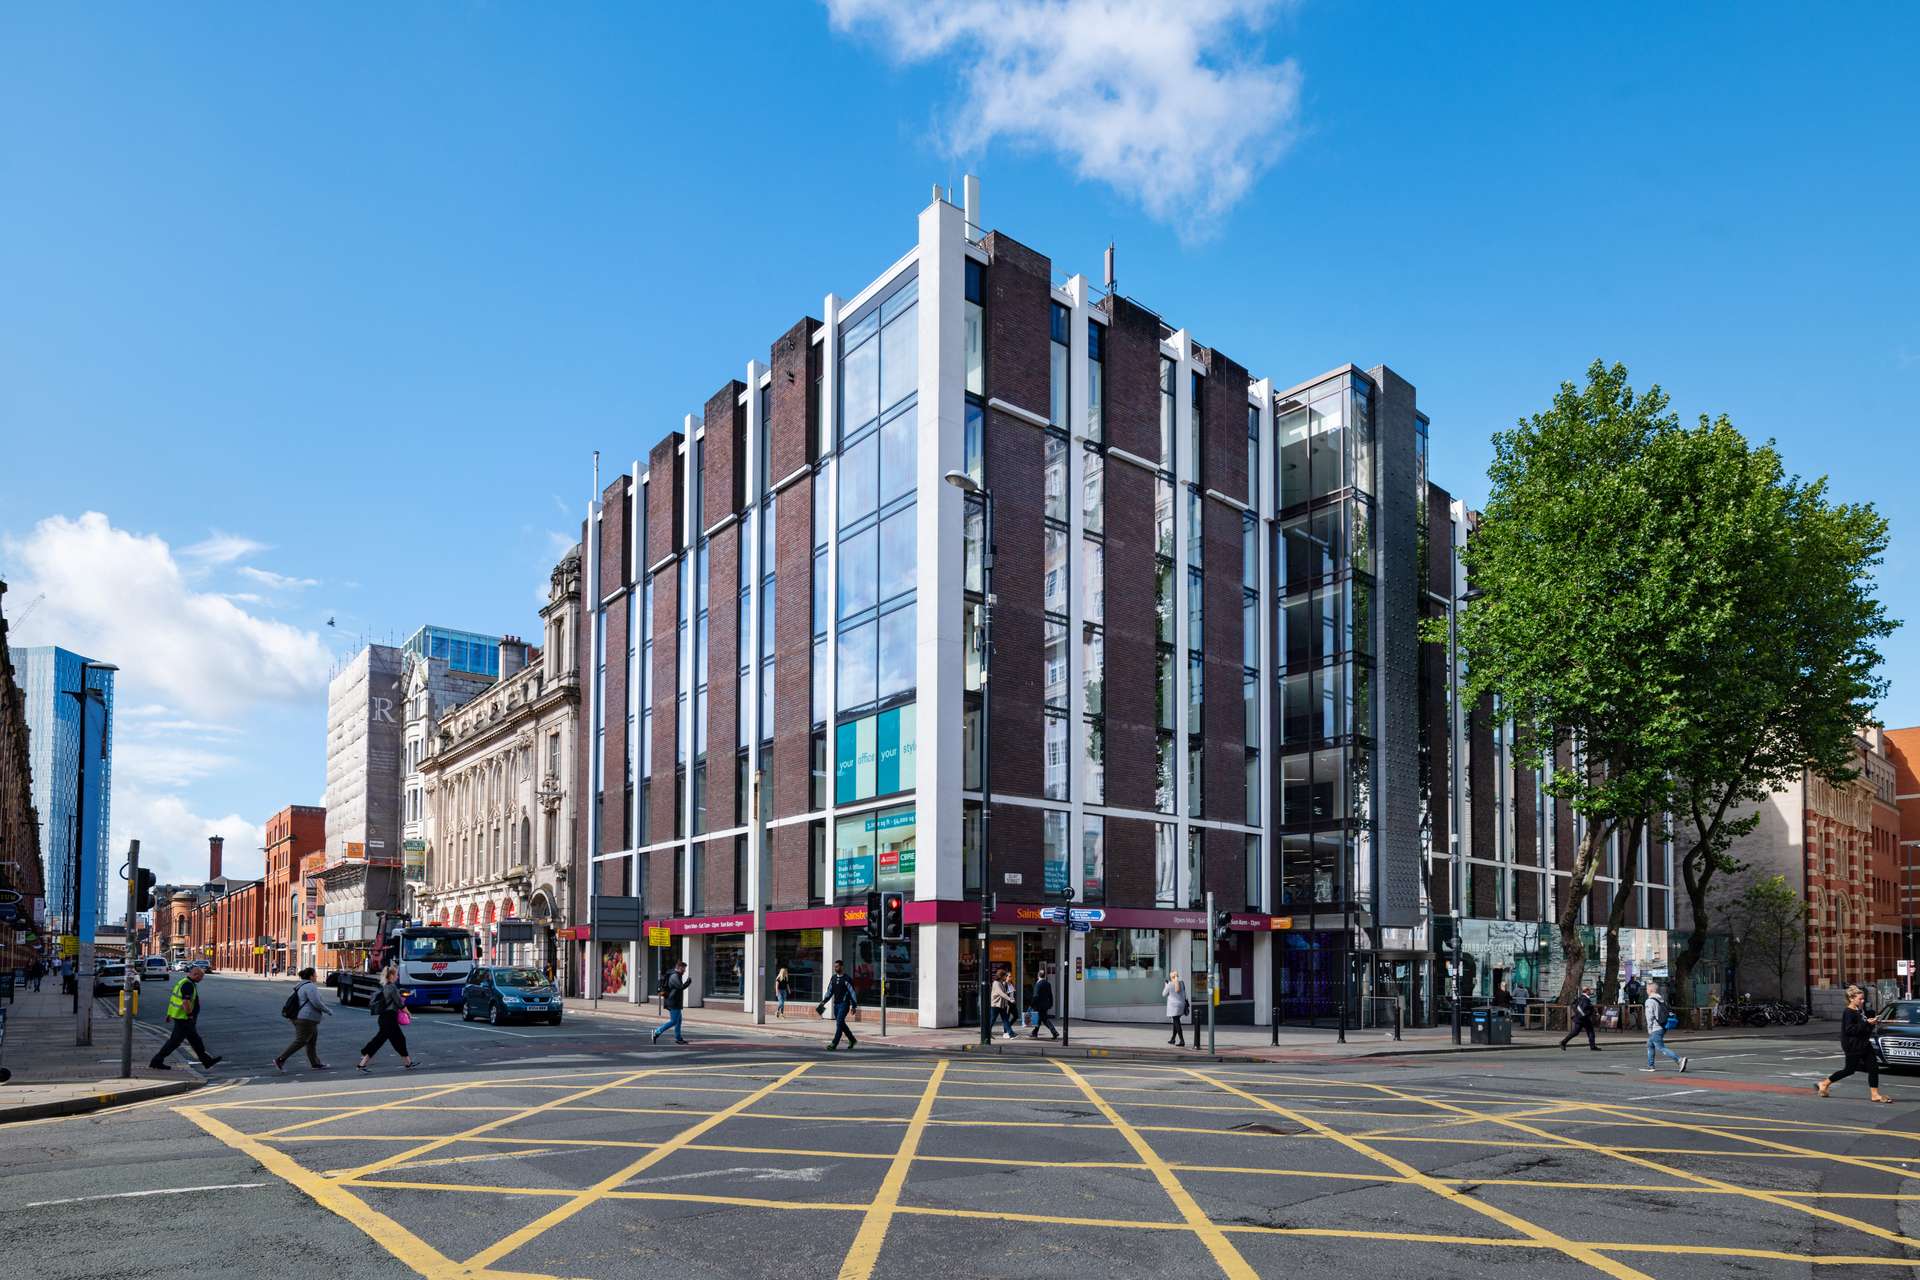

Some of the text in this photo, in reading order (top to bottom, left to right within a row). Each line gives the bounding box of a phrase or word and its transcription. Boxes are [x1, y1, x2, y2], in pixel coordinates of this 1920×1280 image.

[840, 760, 854, 771] your
[881, 749, 897, 762] your
[844, 910, 868, 921] Sainsb
[1016, 908, 1041, 919] Sains
